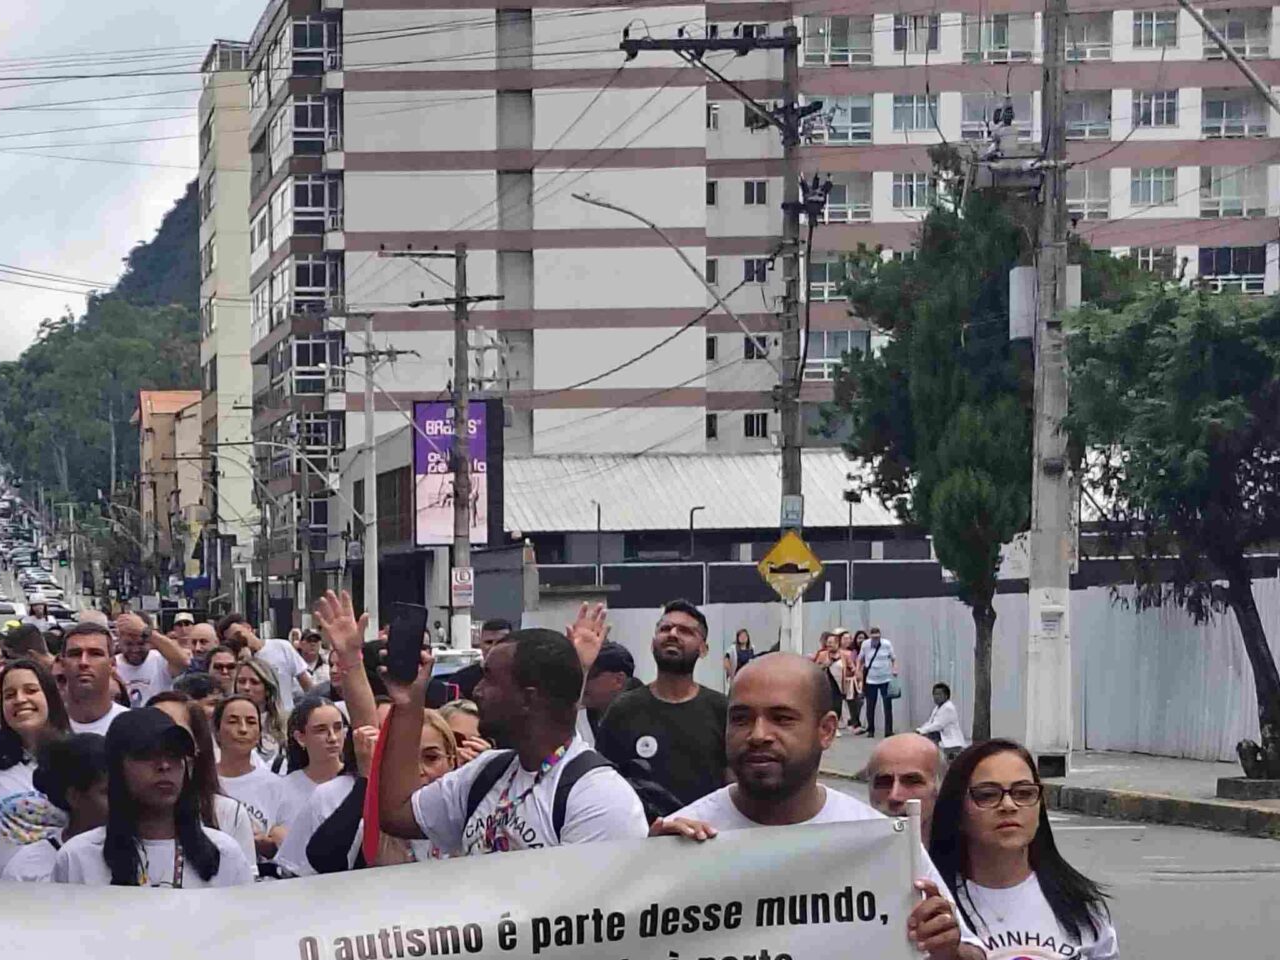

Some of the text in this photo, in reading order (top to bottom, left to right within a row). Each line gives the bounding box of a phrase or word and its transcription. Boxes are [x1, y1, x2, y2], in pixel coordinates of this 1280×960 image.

[497, 911, 517, 950] é
[531, 907, 625, 953] parte
[639, 902, 743, 938] desse
[756, 886, 888, 927] mundo,
